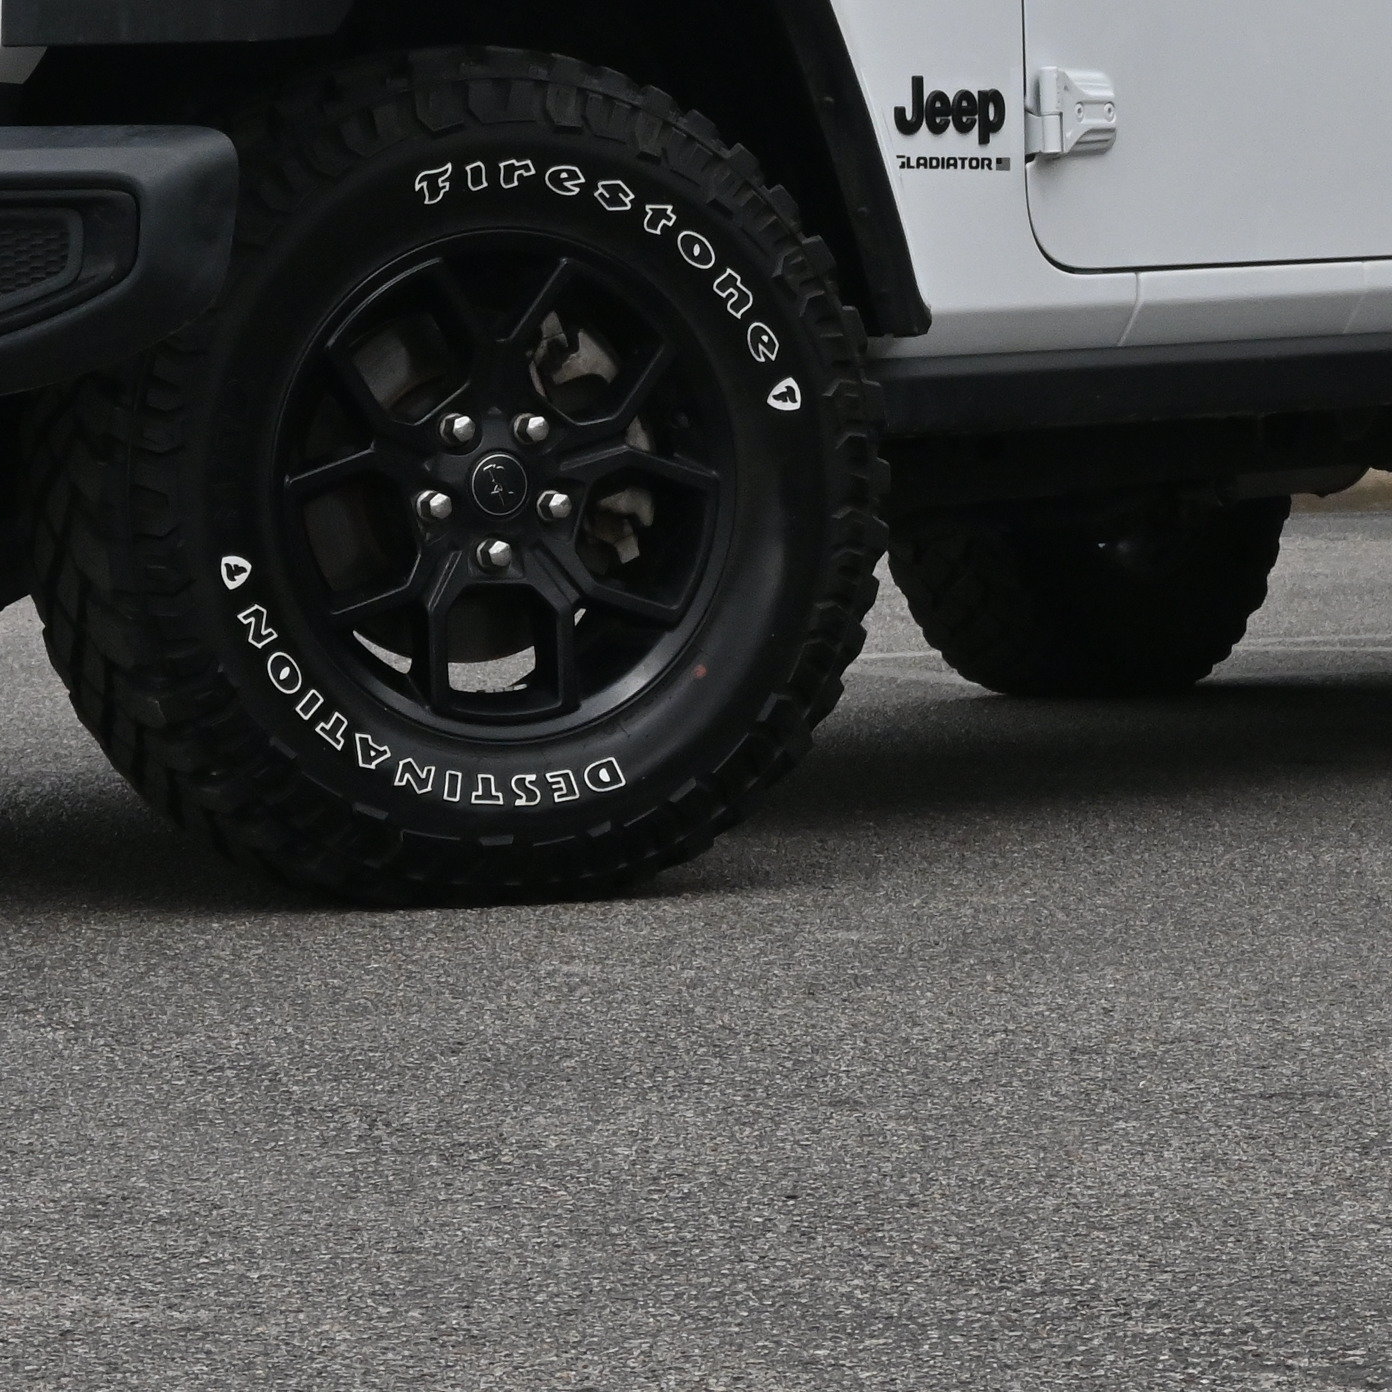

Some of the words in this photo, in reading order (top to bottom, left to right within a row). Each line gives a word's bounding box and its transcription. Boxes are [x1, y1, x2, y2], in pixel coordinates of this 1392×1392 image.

[894, 75, 1006, 145] Jeep
[895, 154, 994, 171] GLADIATOR
[414, 159, 780, 363] Firestone
[237, 603, 628, 807] DESTINATION
